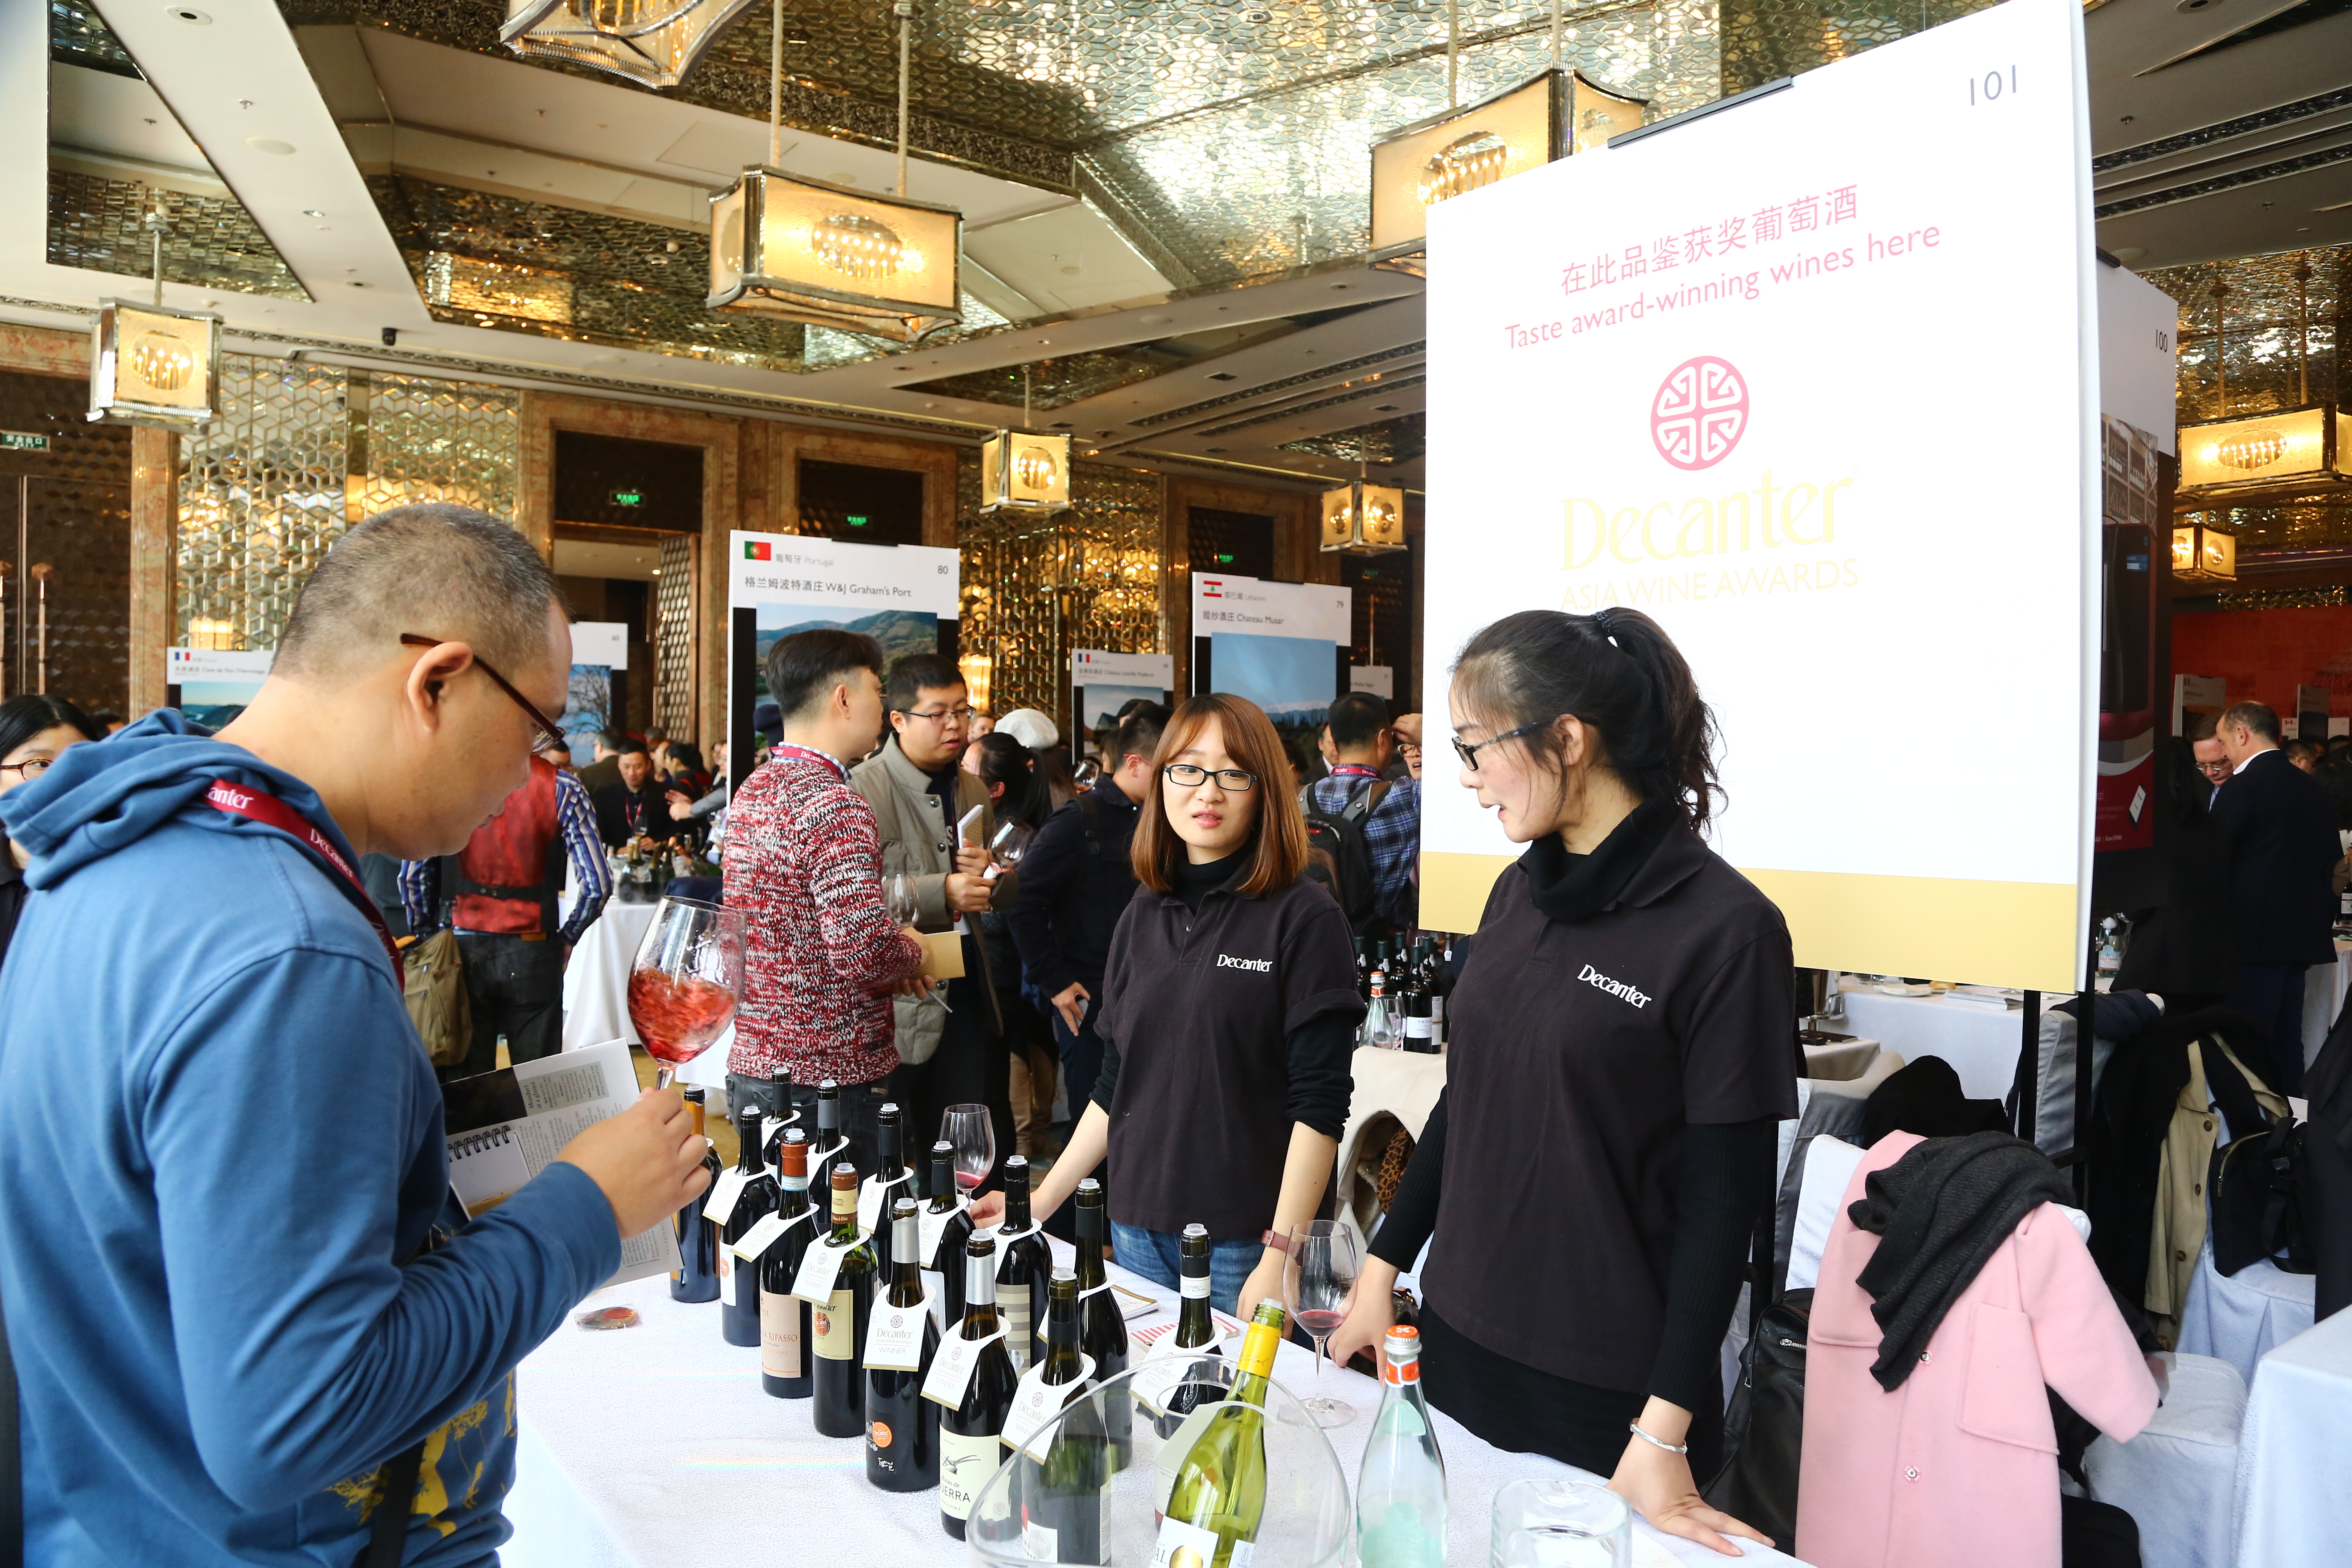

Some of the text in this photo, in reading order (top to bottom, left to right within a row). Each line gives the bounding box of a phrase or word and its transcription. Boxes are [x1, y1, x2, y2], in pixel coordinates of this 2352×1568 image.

[1970, 64, 2016, 107] 101
[1561, 184, 1857, 296] 在此品鉴获奖葡萄酒
[1505, 227, 1940, 349] Taste award-winning wines here
[2156, 329, 2167, 353] 100
[1560, 469, 1855, 570] Decanter
[804, 556, 834, 567] Portugal
[937, 565, 949, 575] 80
[744, 576, 823, 592] 格兰姆波特酒庄
[825, 582, 847, 595] W&J
[892, 587, 911, 597] Port
[1561, 558, 1858, 612] ASIA WINE AWARDS
[1336, 600, 1345, 608] 79
[1265, 616, 1284, 625] Musar
[800, 750, 825, 765] Decanter
[310, 828, 354, 878] Decanter
[1216, 954, 1273, 972] Decanter
[1577, 964, 1653, 1009] Decanter
[806, 1262, 831, 1276] Decanter
[804, 1279, 823, 1290] WINNER
[768, 1332, 797, 1343] RIPASSO
[876, 1327, 913, 1339] Decanter
[879, 1346, 906, 1354] WINNER
[938, 1356, 966, 1375] Decanter
[936, 1376, 955, 1390] WINNER
[1018, 1400, 1048, 1424] Decanter
[1016, 1422, 1034, 1437] WINNE
